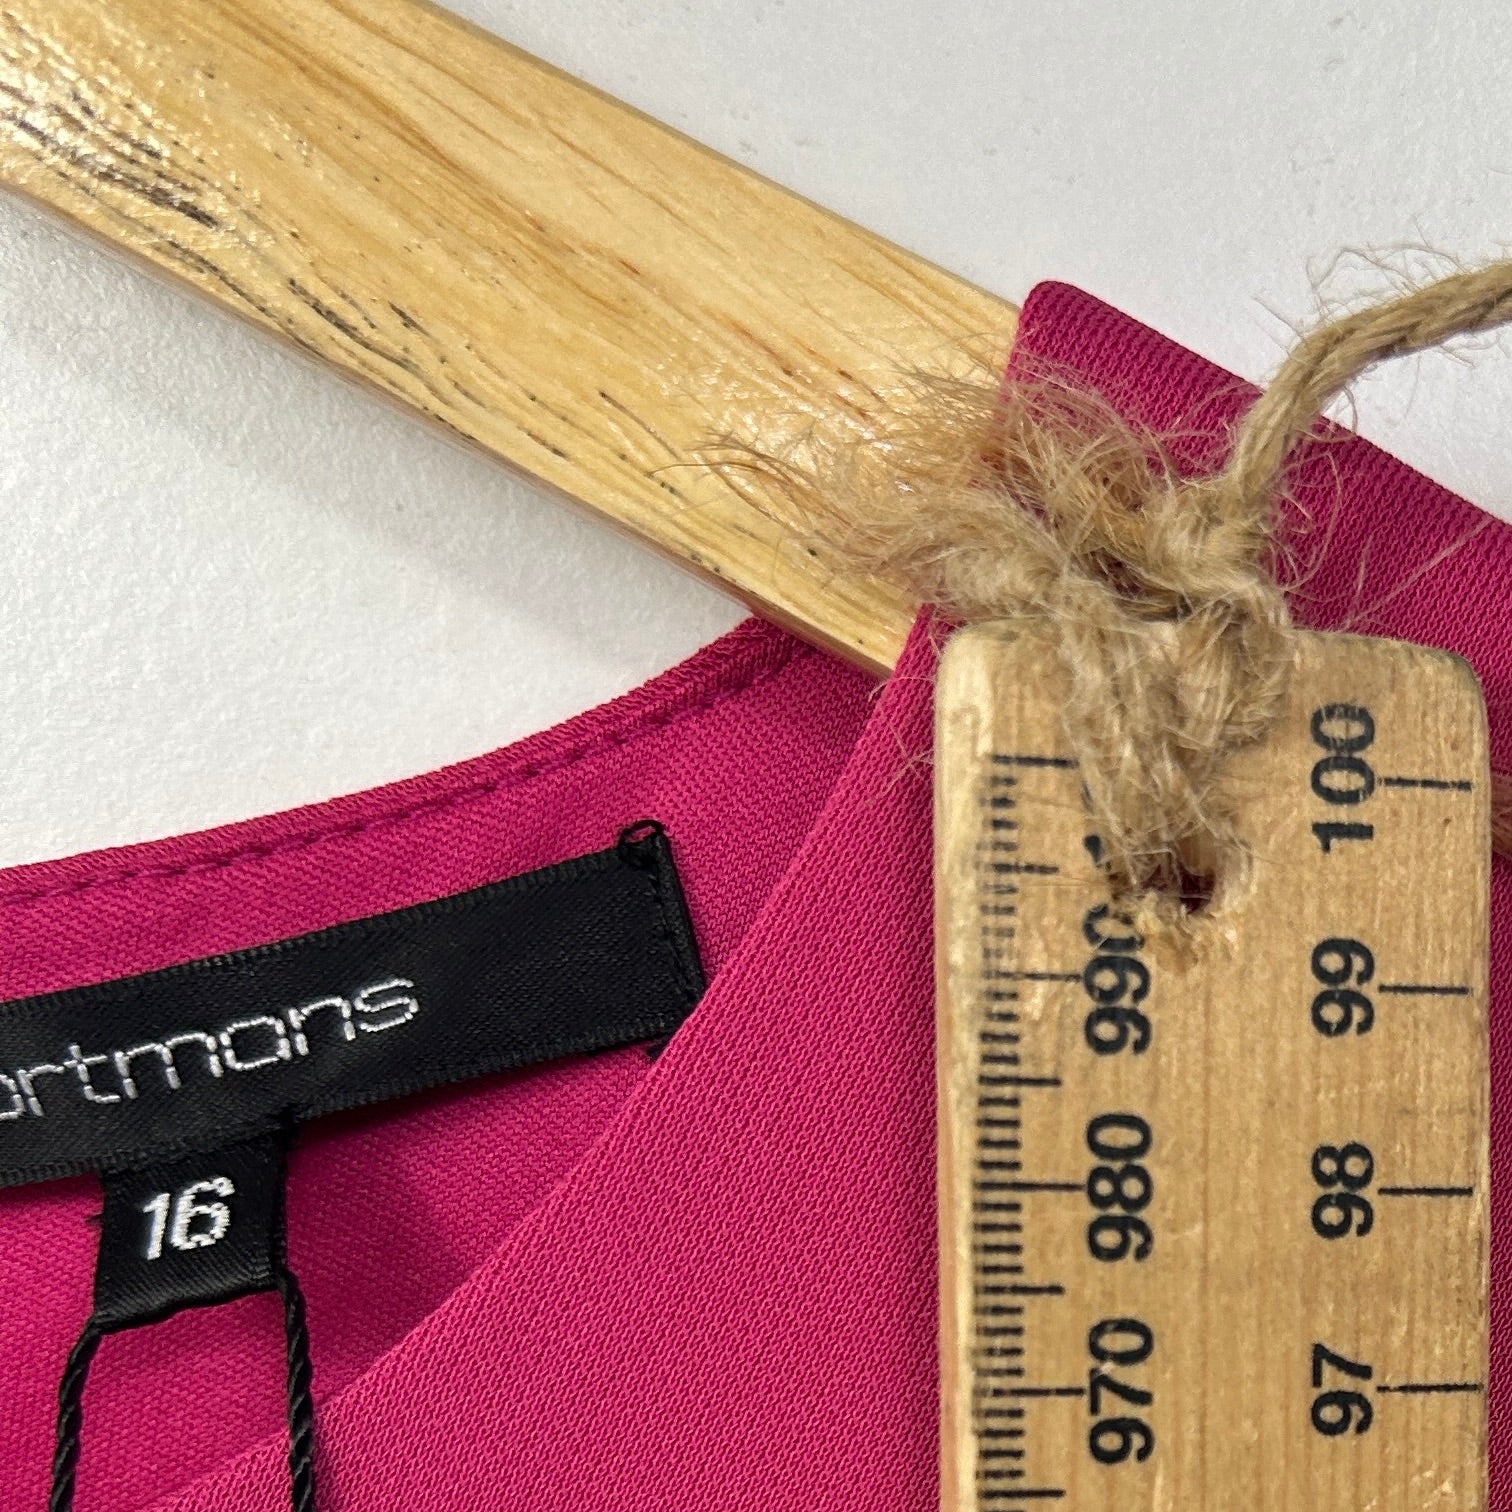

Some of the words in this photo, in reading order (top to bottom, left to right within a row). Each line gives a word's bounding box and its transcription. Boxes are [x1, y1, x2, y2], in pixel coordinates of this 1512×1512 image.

[1311, 703, 1376, 853] 100
[1082, 903, 1151, 1056] 990
[1311, 937, 1375, 1037] 99
[143, 1176, 235, 1261] 16
[1086, 1112, 1153, 1262] 980
[1311, 1142, 1375, 1240] 98
[1088, 1317, 1154, 1465] 970
[1311, 1343, 1373, 1437] 97
